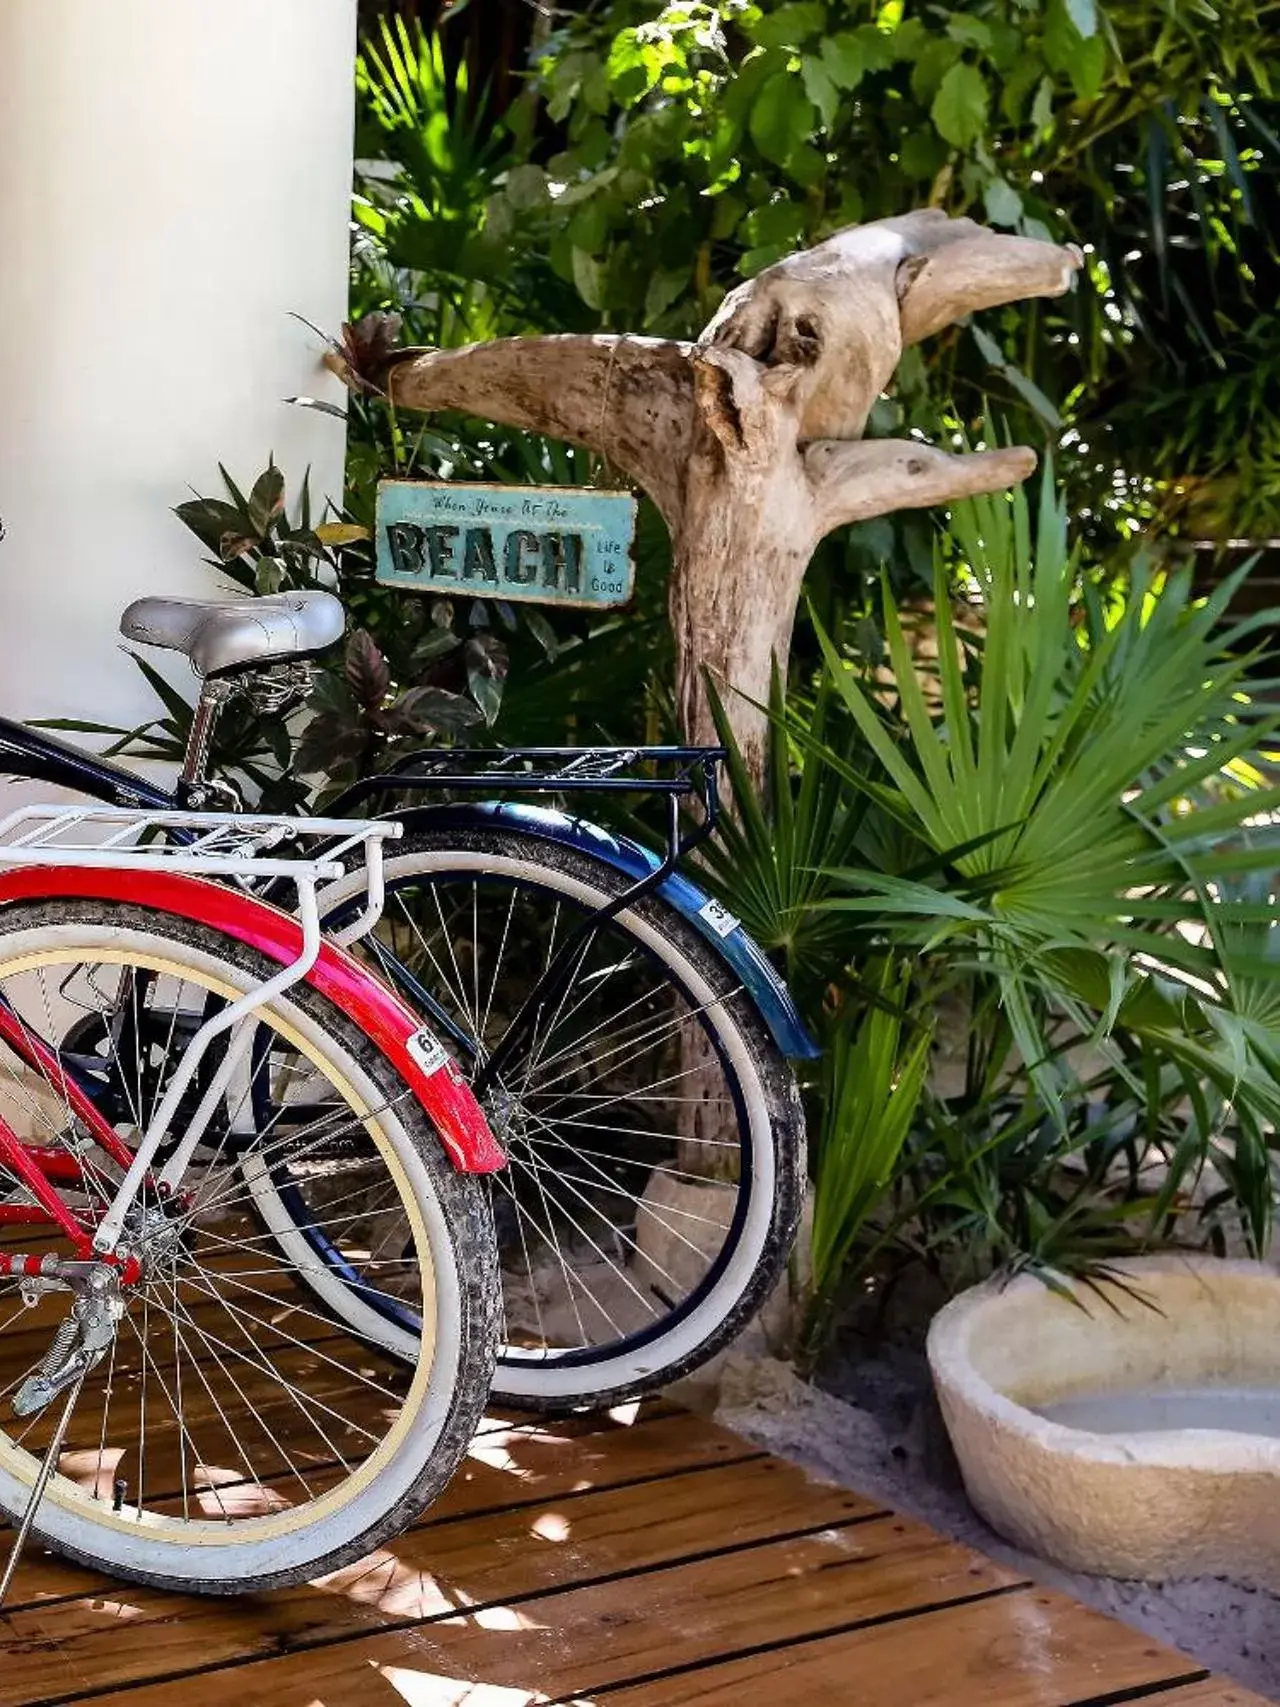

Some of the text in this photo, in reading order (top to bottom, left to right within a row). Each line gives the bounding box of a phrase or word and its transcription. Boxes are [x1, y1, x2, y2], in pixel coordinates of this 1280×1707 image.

[433, 495, 466, 513] When
[596, 540, 621, 555] Life
[386, 521, 584, 594] BEACH
[590, 577, 624, 595] Good
